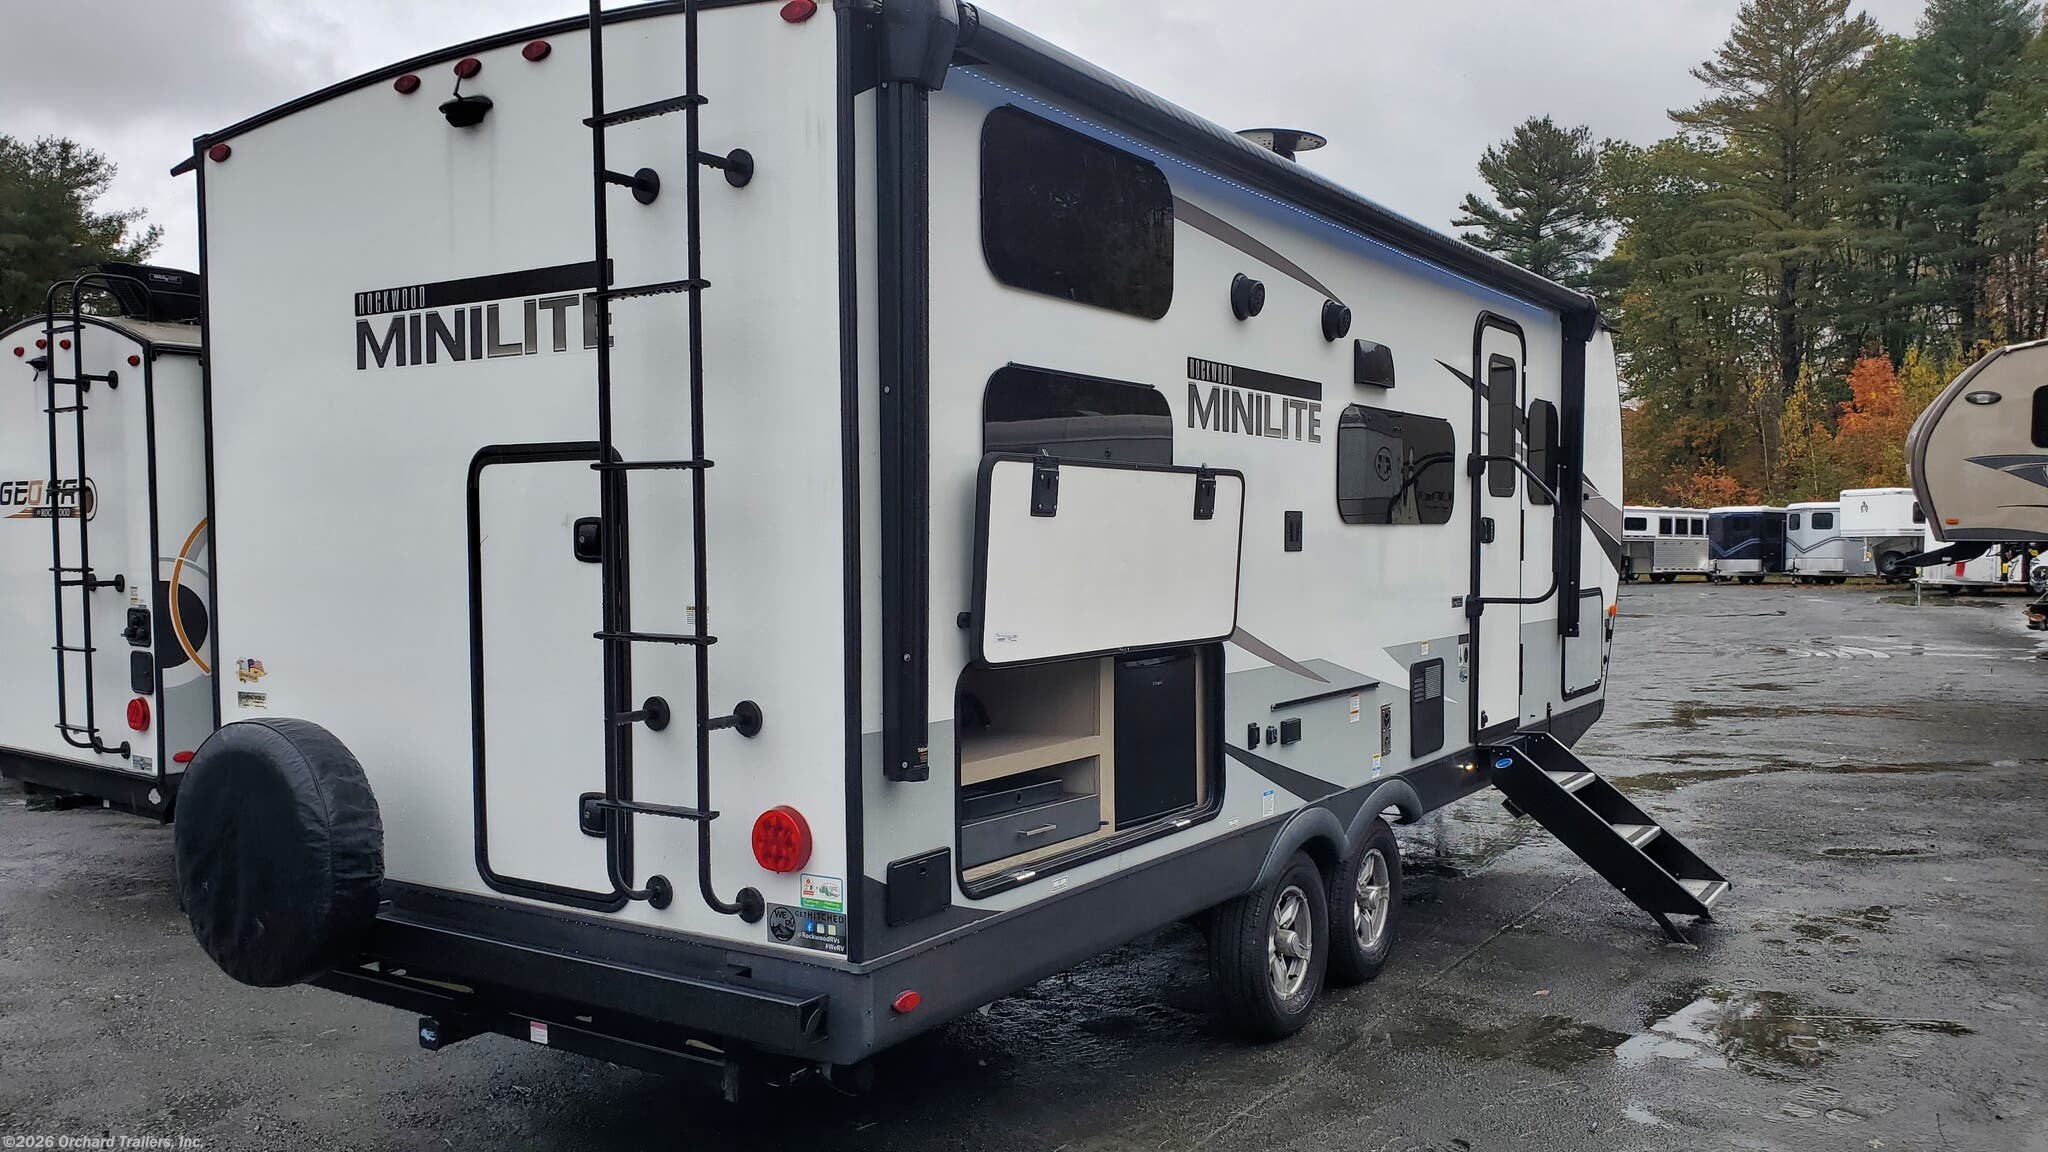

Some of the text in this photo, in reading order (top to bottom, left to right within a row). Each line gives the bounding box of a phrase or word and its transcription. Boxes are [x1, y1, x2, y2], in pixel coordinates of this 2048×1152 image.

[358, 285, 425, 315] ROCKWOOD
[355, 292, 614, 370] MINILITE
[1189, 358, 1233, 385] ROCKWOOD
[1187, 381, 1322, 444] MINILITE
[40, 508, 71, 517] ROCOOD
[774, 909, 787, 919] WE
